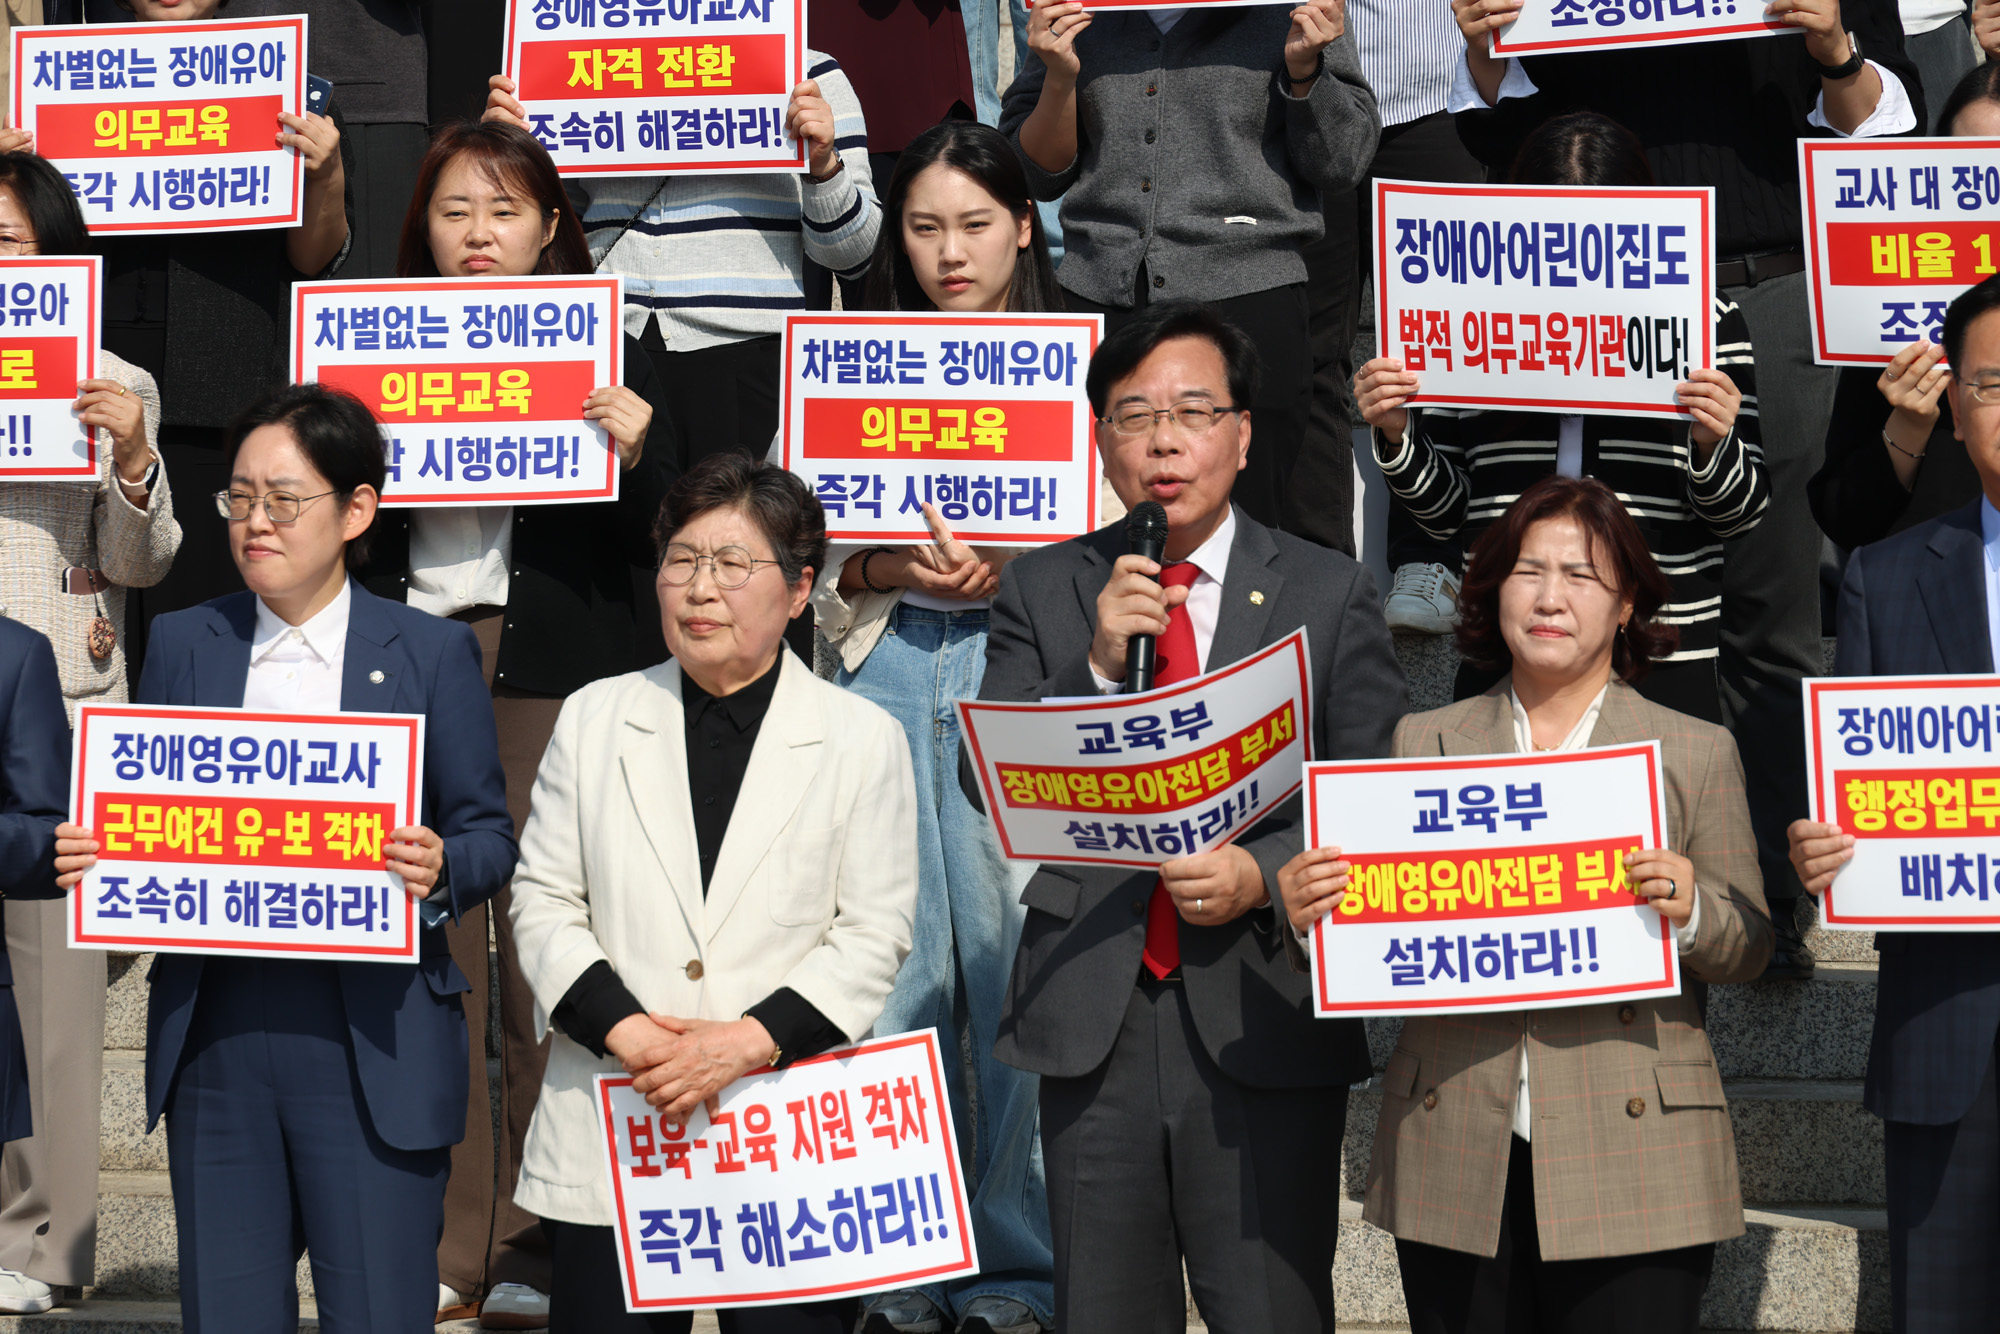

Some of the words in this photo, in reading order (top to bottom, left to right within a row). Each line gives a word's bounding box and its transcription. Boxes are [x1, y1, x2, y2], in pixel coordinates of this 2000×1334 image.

[33, 49, 156, 90] 차별없는
[169, 41, 286, 87] 장애유아
[568, 48, 642, 90] 자격
[657, 45, 735, 88] 전환
[95, 106, 230, 150] 의무교육
[529, 111, 624, 152] 조속히
[637, 108, 781, 150] 해결하라!
[129, 166, 269, 210] 시행하라!
[1836, 167, 1897, 210] 교사
[1910, 167, 1939, 210] 대
[1396, 219, 1689, 289] 장애아어린이집도
[1871, 233, 1954, 278] 비율
[1972, 235, 1996, 274] 1
[315, 306, 449, 350] 차별없는
[462, 303, 598, 348] 장애유아
[1400, 310, 1452, 371] 법적
[1463, 312, 1689, 380] 의무교육기관이다!
[802, 339, 926, 384] 차별없는
[939, 341, 1077, 386] 장애유아
[381, 370, 532, 415] 의무교육
[862, 407, 1008, 452] 의무교육
[419, 436, 579, 481] 시행하라!
[816, 475, 885, 518] 즉각
[899, 474, 1056, 520] 시행하라!
[1077, 701, 1212, 754] 교육부
[1838, 705, 2000, 756] 장애아어
[112, 734, 381, 788] 장애영유아교사
[1002, 748, 1230, 807] 장애영유아전담
[1242, 709, 1291, 763] 부서
[105, 804, 222, 854] 근무여건
[235, 808, 312, 856] 유-보
[324, 813, 384, 861] 격차
[1065, 781, 1258, 854] 설치하라!!
[1413, 783, 1547, 833] 교육부
[1339, 855, 1562, 915] 장애영유아전담
[1900, 854, 2000, 901] 배치
[97, 877, 207, 925] 조속히
[225, 880, 388, 931] 해결하라!
[1383, 927, 1598, 986] 설치하라!!
[628, 1104, 777, 1179] 보육-교육
[787, 1091, 856, 1163] 지원
[864, 1077, 928, 1149] 격차
[640, 1207, 723, 1274] 즉각
[737, 1173, 947, 1267] 해소하라!!
